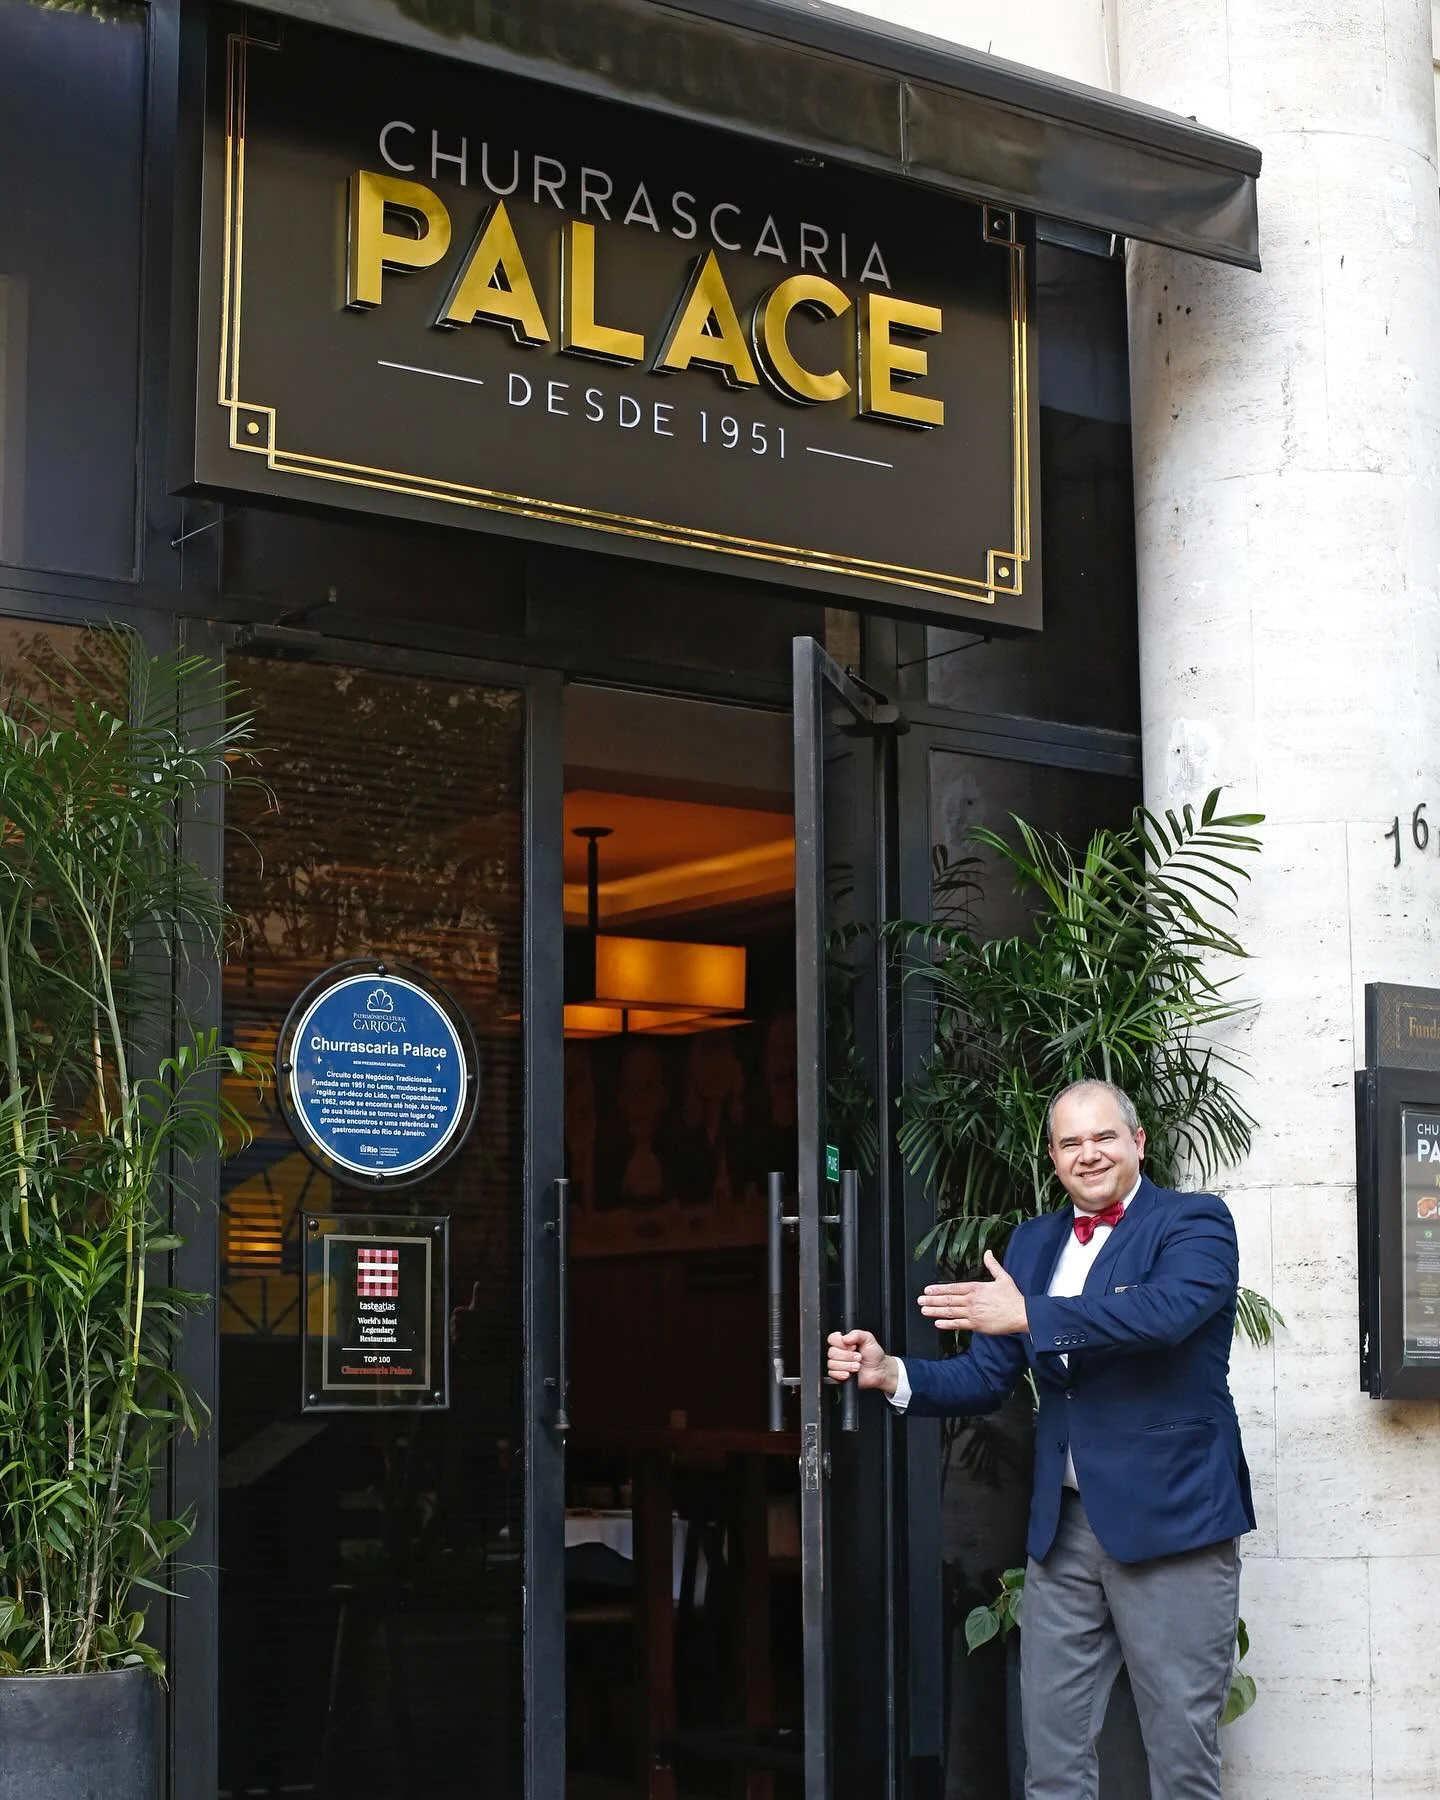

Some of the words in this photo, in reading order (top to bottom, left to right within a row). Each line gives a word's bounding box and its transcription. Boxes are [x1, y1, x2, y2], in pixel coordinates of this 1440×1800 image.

[378, 120, 893, 290] CHURRASCARIA
[345, 168, 945, 429] PALACE
[509, 373, 674, 437] DESDE
[699, 410, 787, 459] 1951
[1384, 803, 1429, 868] 16
[353, 1019, 406, 1033] CARIOCA
[311, 1036, 399, 1055] Churrascaria
[403, 1042, 447, 1058] Palace
[326, 1070, 351, 1079] Circuito
[366, 1073, 394, 1082] Negócios
[396, 1075, 432, 1083] Tradicionais
[376, 1083, 395, 1091] Leme,
[401, 1093, 440, 1102] Copacabana,
[404, 1102, 419, 1110] hoje.
[430, 1104, 448, 1112] longo
[1417, 1123, 1439, 1136] CHU
[1418, 1139, 1440, 1163] PA
[360, 1301, 396, 1312] tasteatlas
[362, 1326, 395, 1335] Legendary
